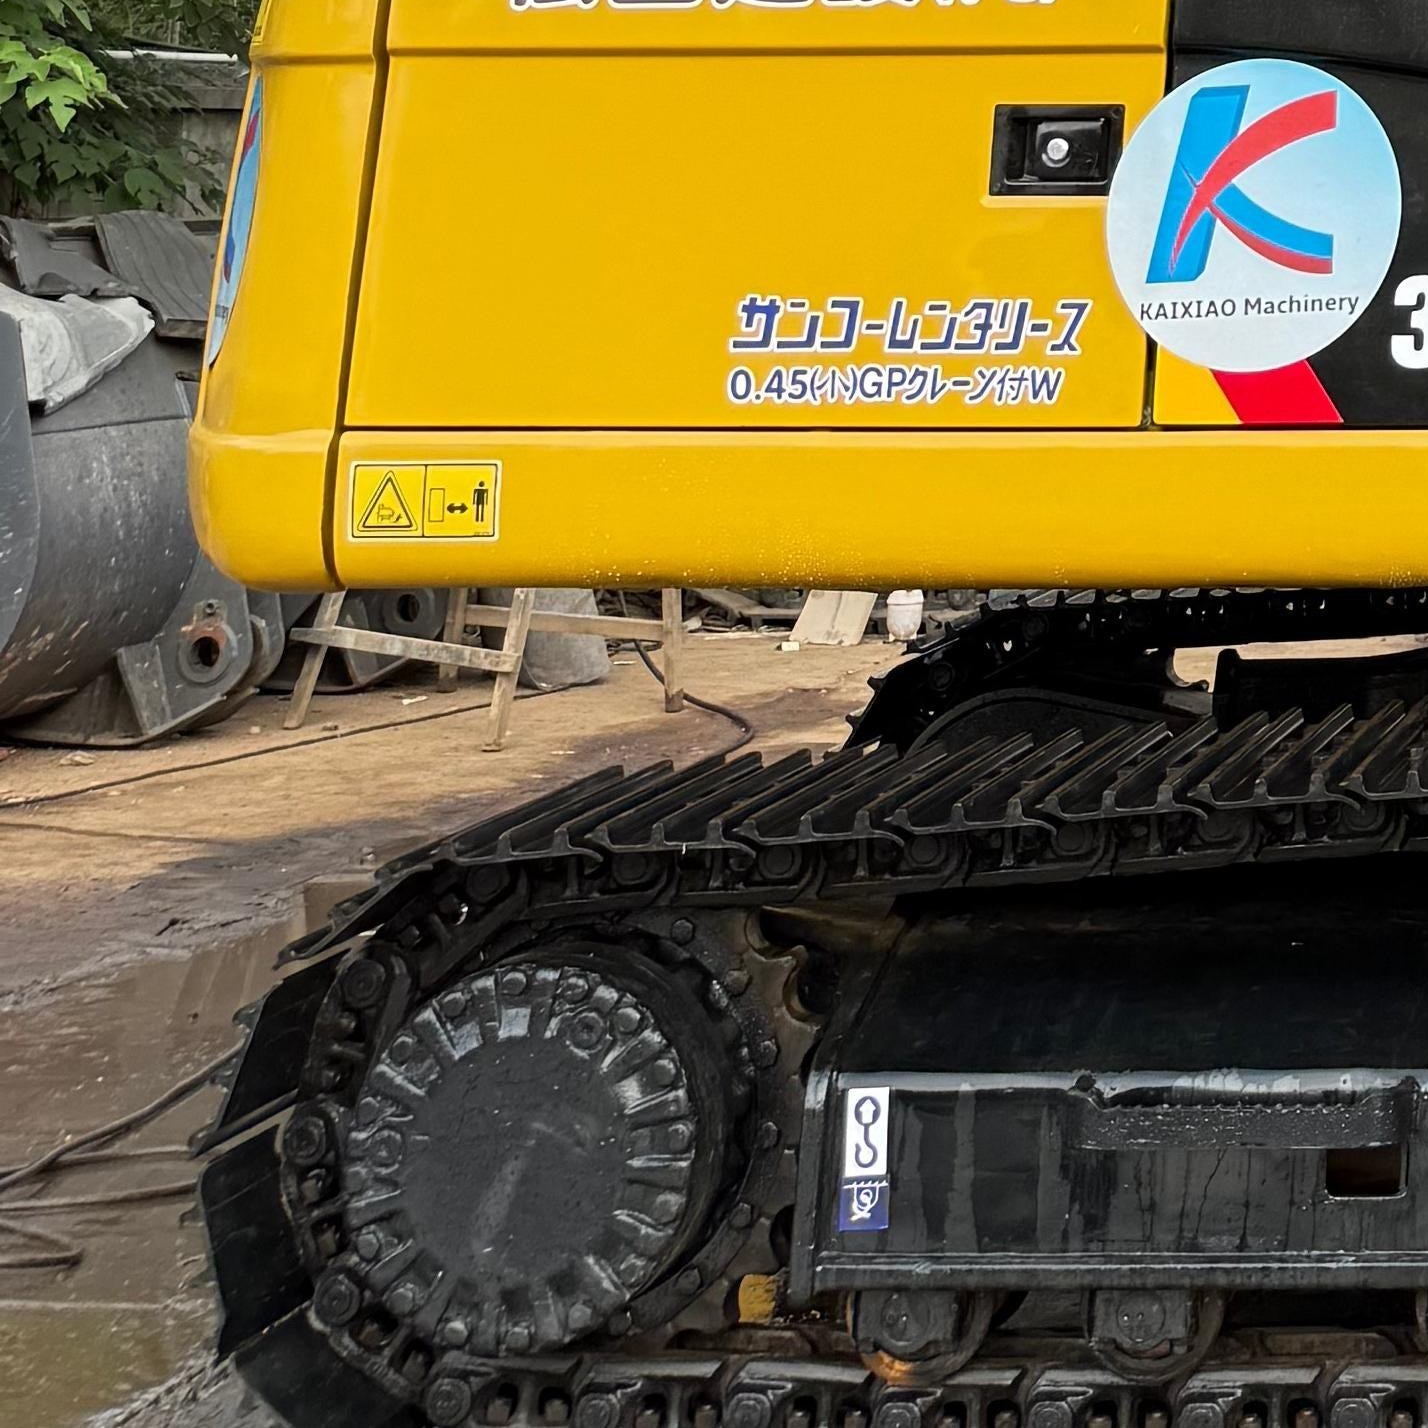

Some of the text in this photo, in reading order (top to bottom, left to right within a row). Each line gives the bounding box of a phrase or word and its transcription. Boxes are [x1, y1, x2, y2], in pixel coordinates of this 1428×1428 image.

[730, 295, 1093, 353] サンコーレンタリース
[1140, 295, 1360, 321] KAIXIAO Machinery
